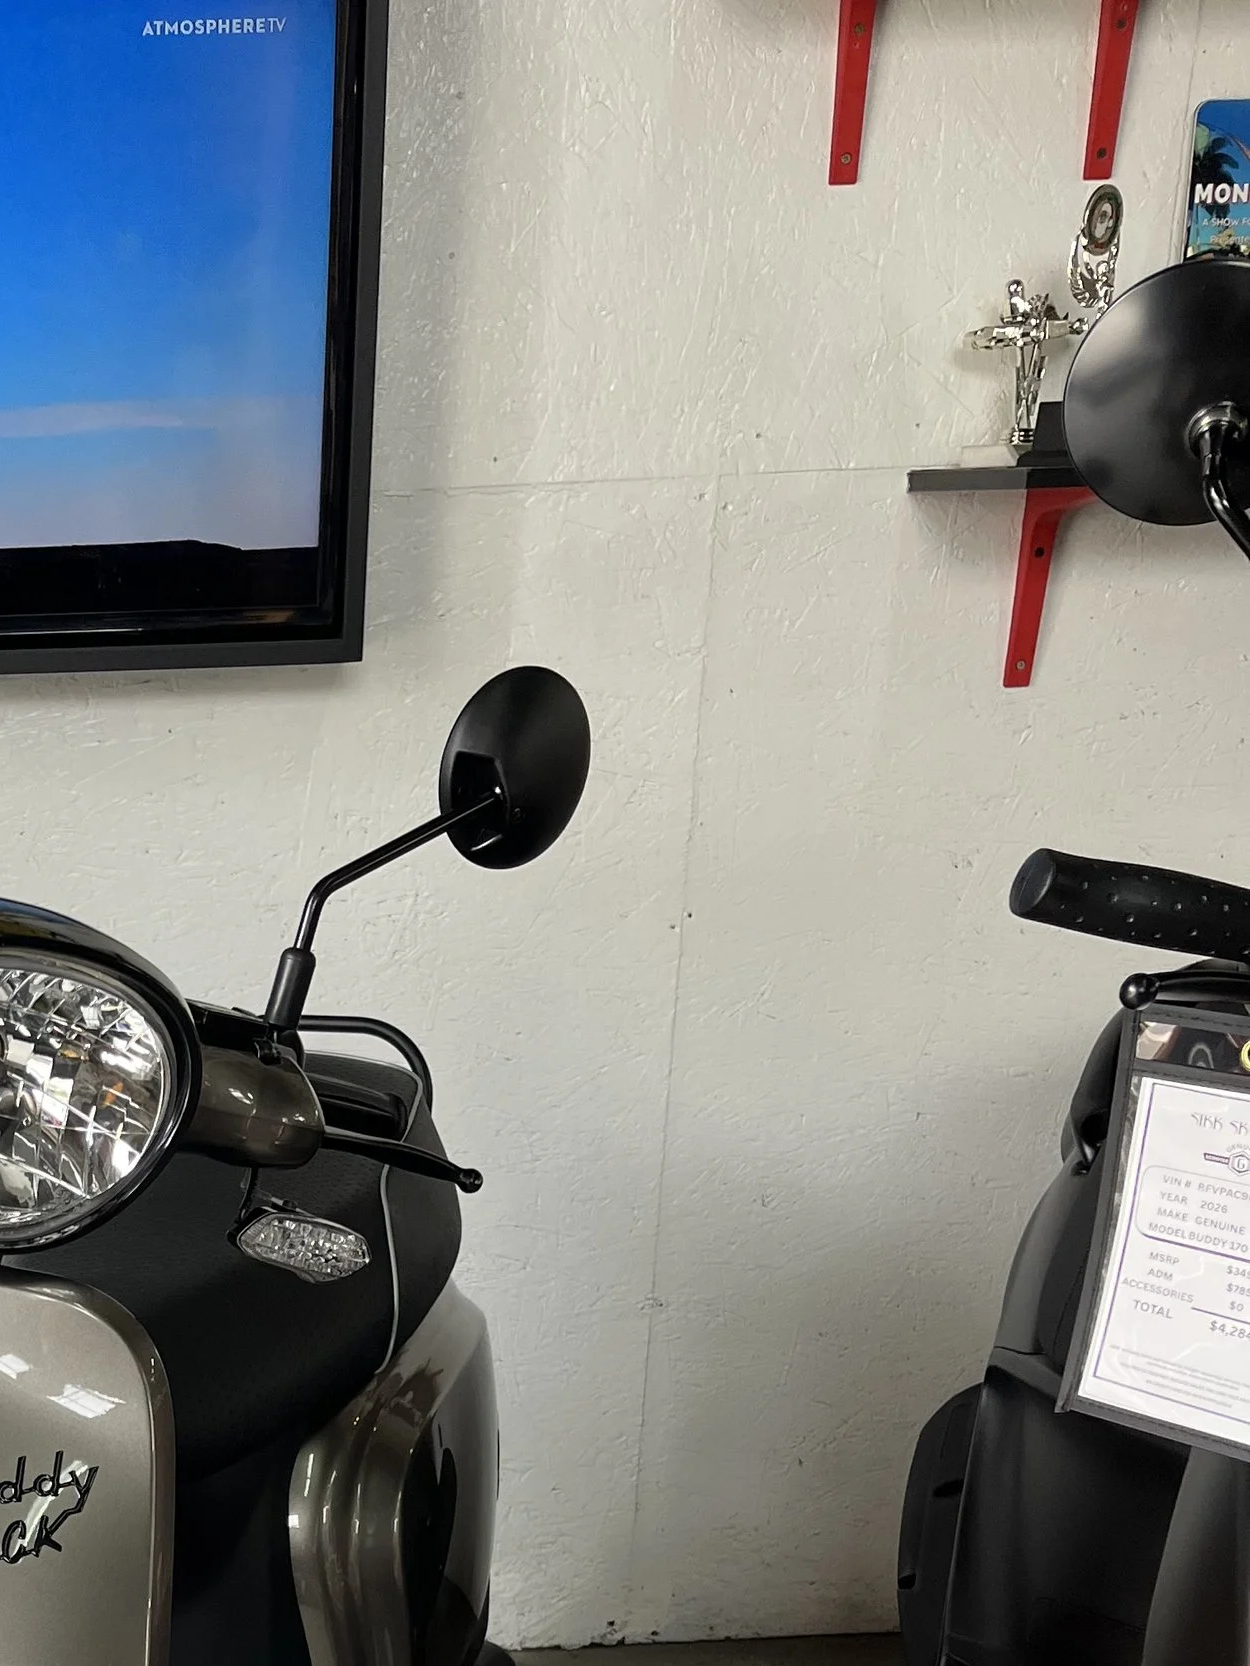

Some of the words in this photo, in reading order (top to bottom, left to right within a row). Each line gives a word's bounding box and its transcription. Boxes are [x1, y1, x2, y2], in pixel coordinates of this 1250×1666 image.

[1162, 1175, 1181, 1187] VIN
[1160, 1191, 1188, 1205] YEAR
[1200, 1200, 1228, 1214] 2026
[1157, 1207, 1189, 1222] MAKE
[1195, 1216, 1247, 1235] GENUINE
[1148, 1222, 1186, 1239] MODEL
[1189, 1231, 1228, 1248] BUDDY
[1229, 1241, 1249, 1253] 170
[1149, 1252, 1180, 1266] MSRP
[1147, 1267, 1174, 1281] ADM
[1122, 1277, 1194, 1304] ACCESSORIES
[1230, 1301, 1244, 1312] $0
[1133, 1299, 1174, 1320] TOTAL
